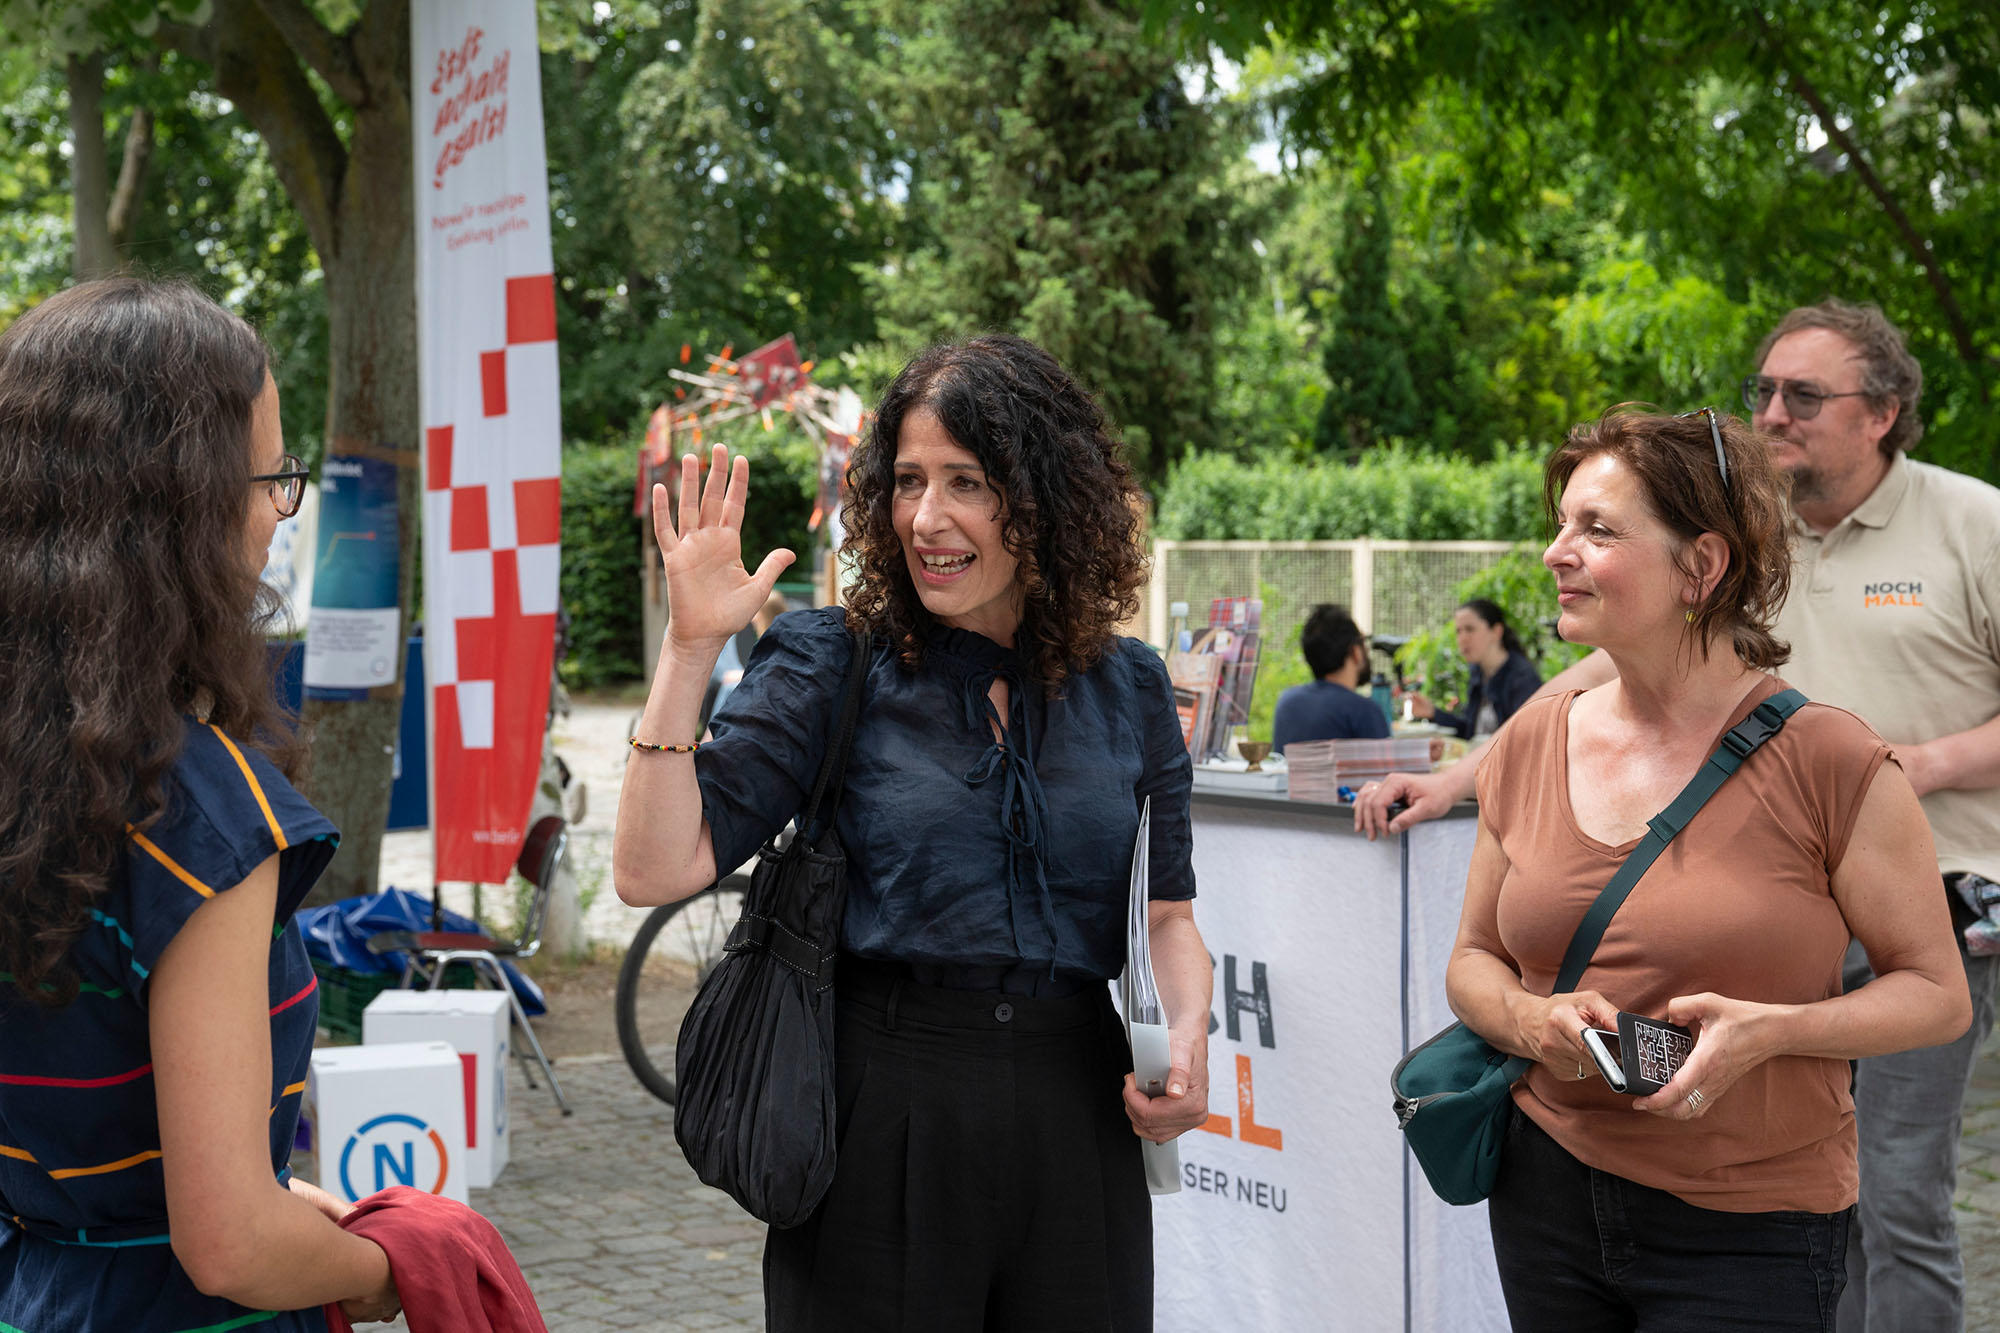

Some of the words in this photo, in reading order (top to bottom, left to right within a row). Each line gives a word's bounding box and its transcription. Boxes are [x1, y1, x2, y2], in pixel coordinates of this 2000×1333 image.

[1864, 582, 1922, 595] NOCH
[1864, 593, 1924, 608] MALL
[1207, 953, 1276, 1050] H
[373, 1141, 416, 1192] N
[1180, 1162, 1229, 1198] SER
[1237, 1176, 1287, 1213] NEU
